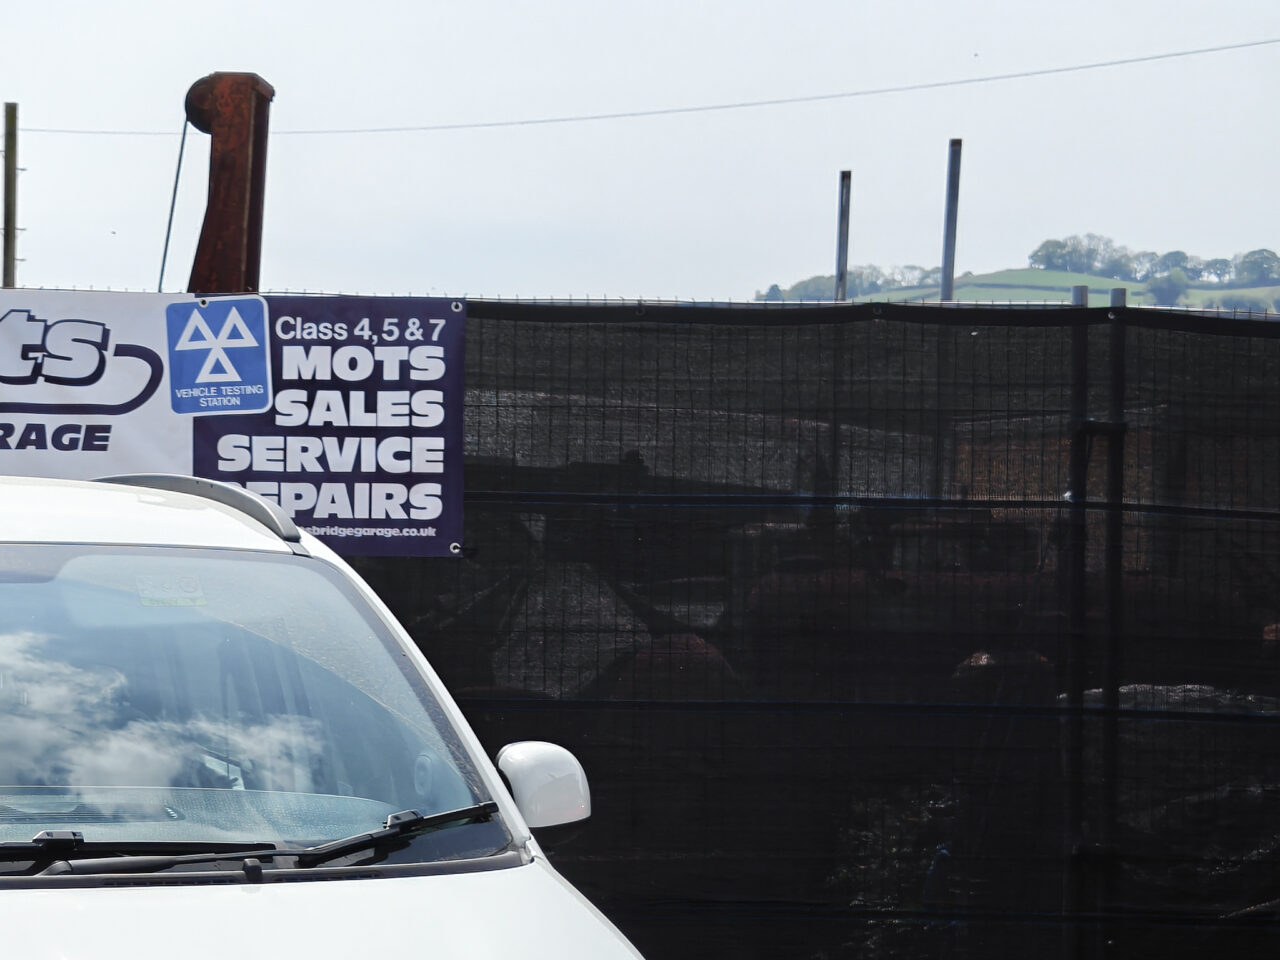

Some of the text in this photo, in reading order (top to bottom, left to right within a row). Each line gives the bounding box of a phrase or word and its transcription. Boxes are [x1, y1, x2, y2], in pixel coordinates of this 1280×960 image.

[275, 315, 348, 340] Class
[429, 319, 446, 341] 7
[282, 345, 446, 381] MOTS
[175, 385, 264, 398] VEHICLE TESTING
[199, 396, 241, 407] STATION
[274, 389, 445, 427] SALES
[217, 434, 445, 473] SERVICE
[222, 481, 443, 520] PAIRS
[300, 526, 437, 537] sbridgegarage.co.uk
